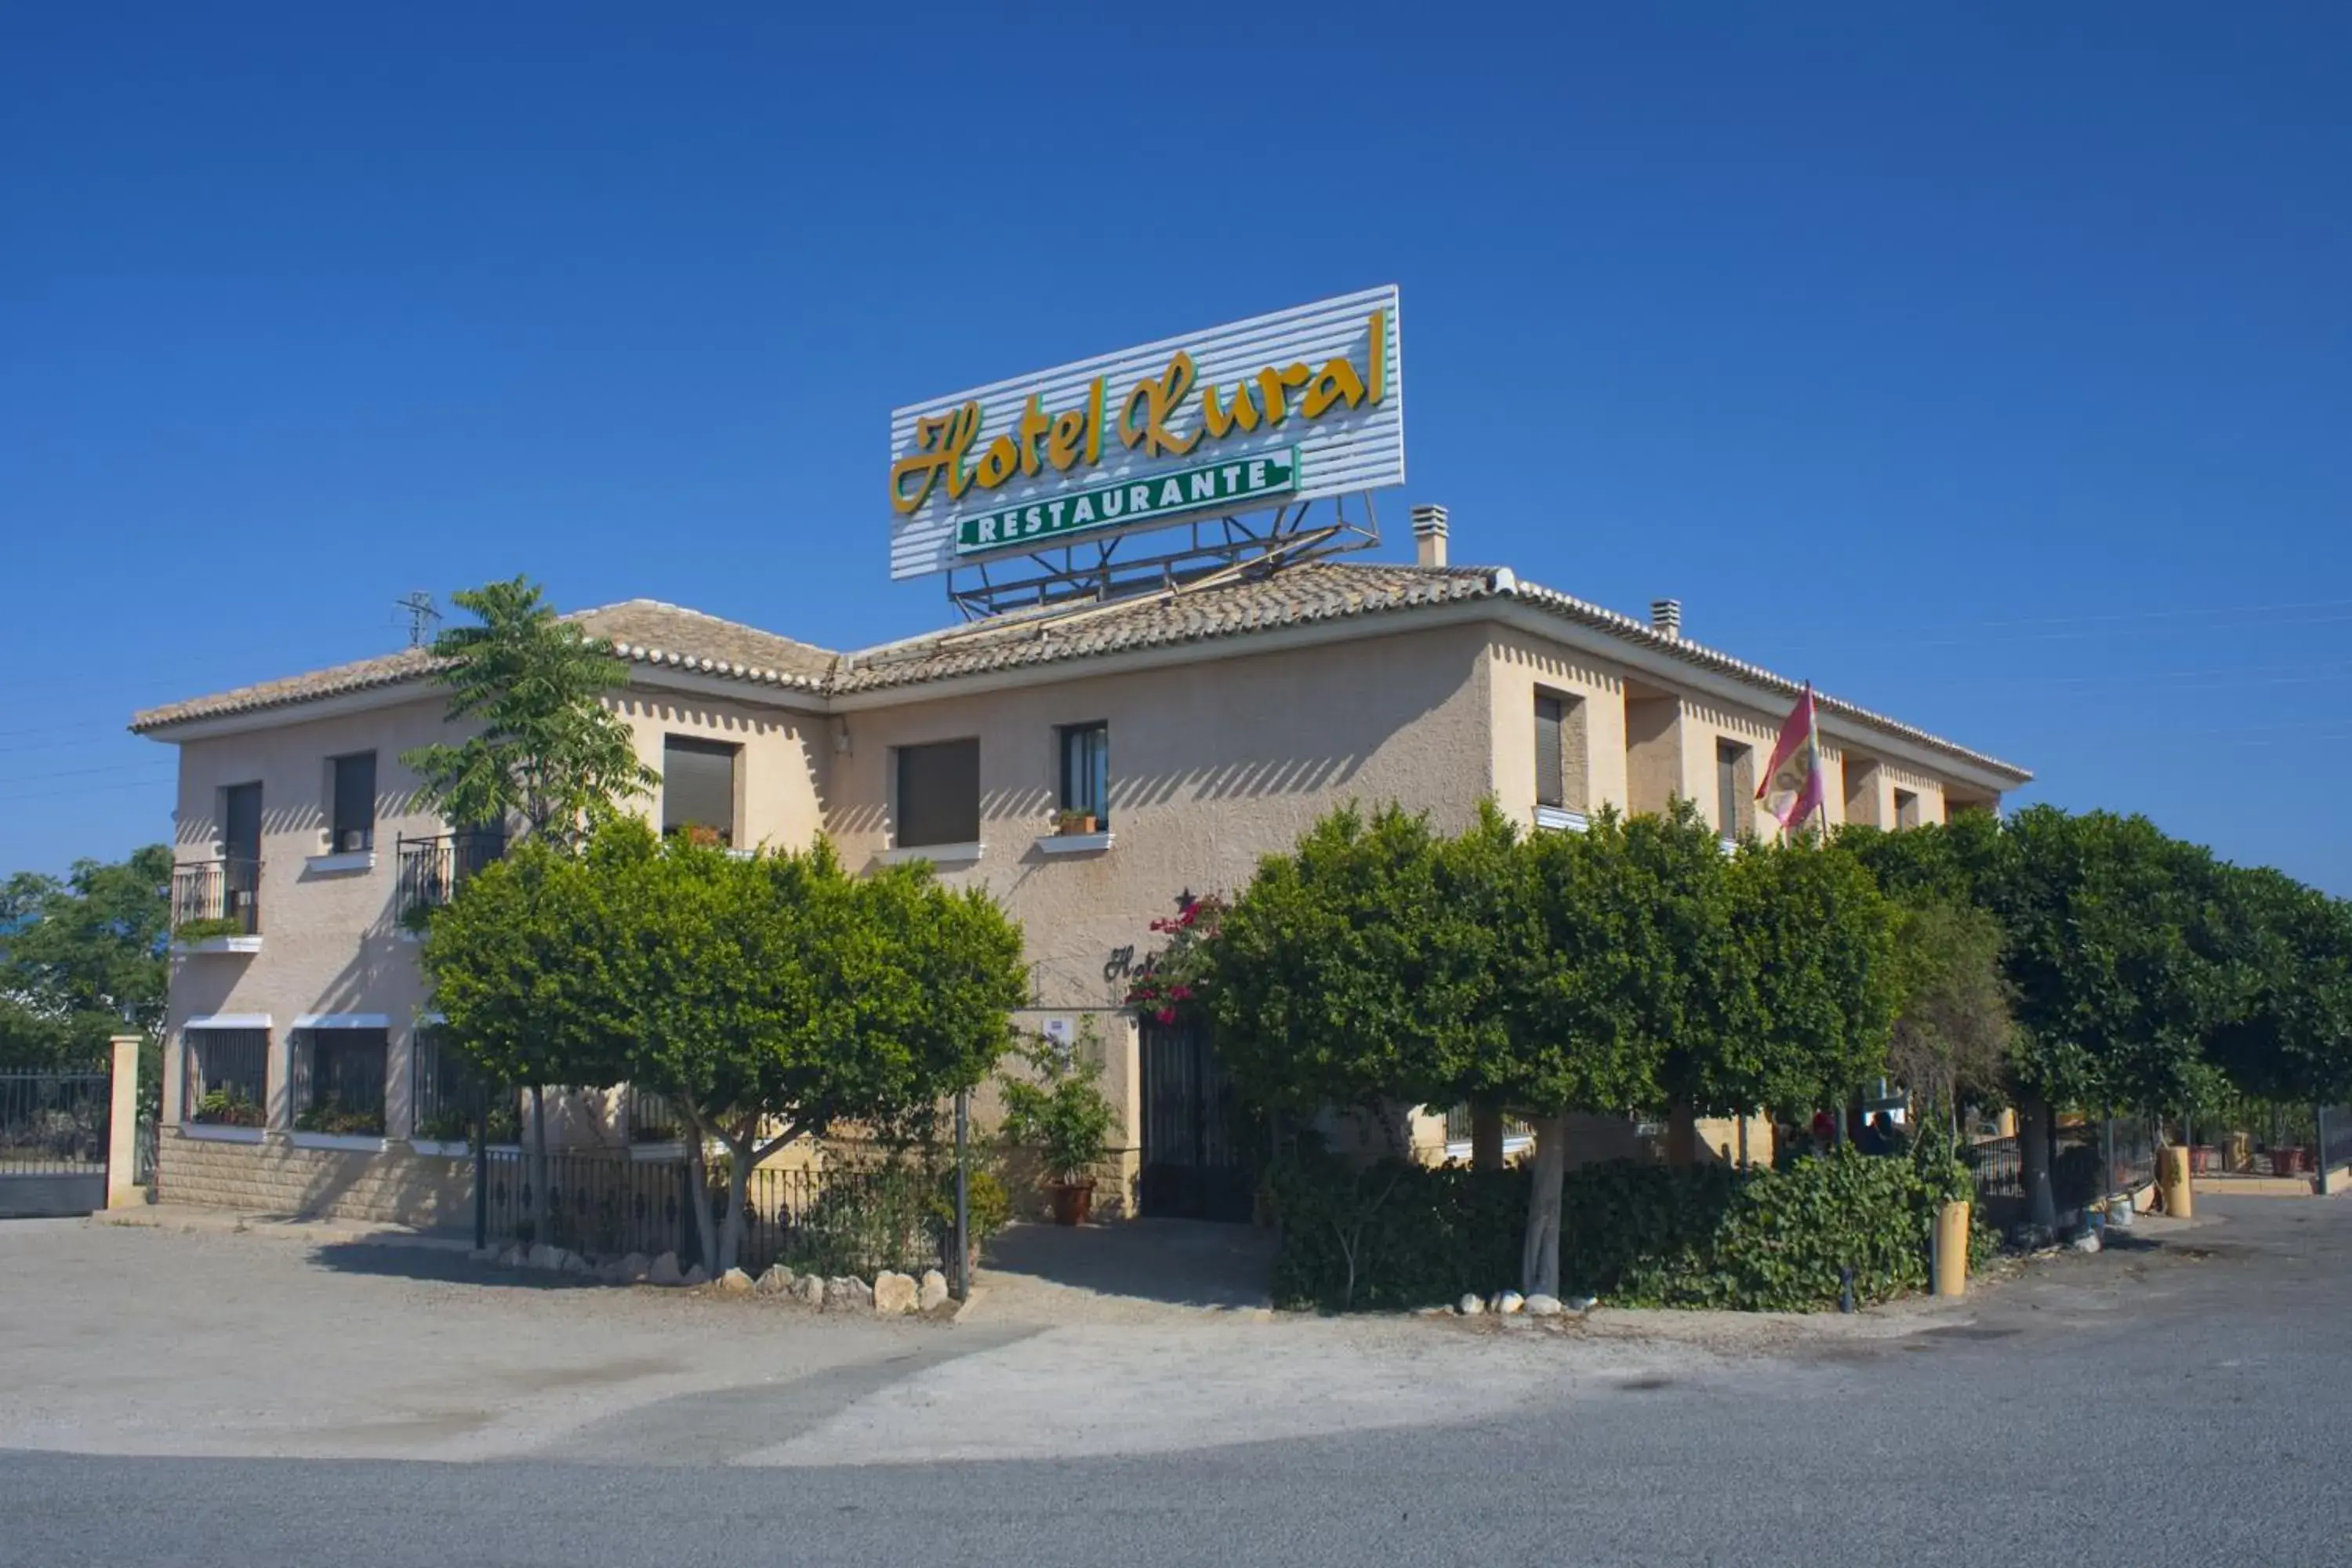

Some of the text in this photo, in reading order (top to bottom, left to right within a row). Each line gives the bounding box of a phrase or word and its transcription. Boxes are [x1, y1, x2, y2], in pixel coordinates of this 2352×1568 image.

[890, 308, 1388, 514] Hotel Rural
[978, 459, 1266, 543] RESTAURANTE
